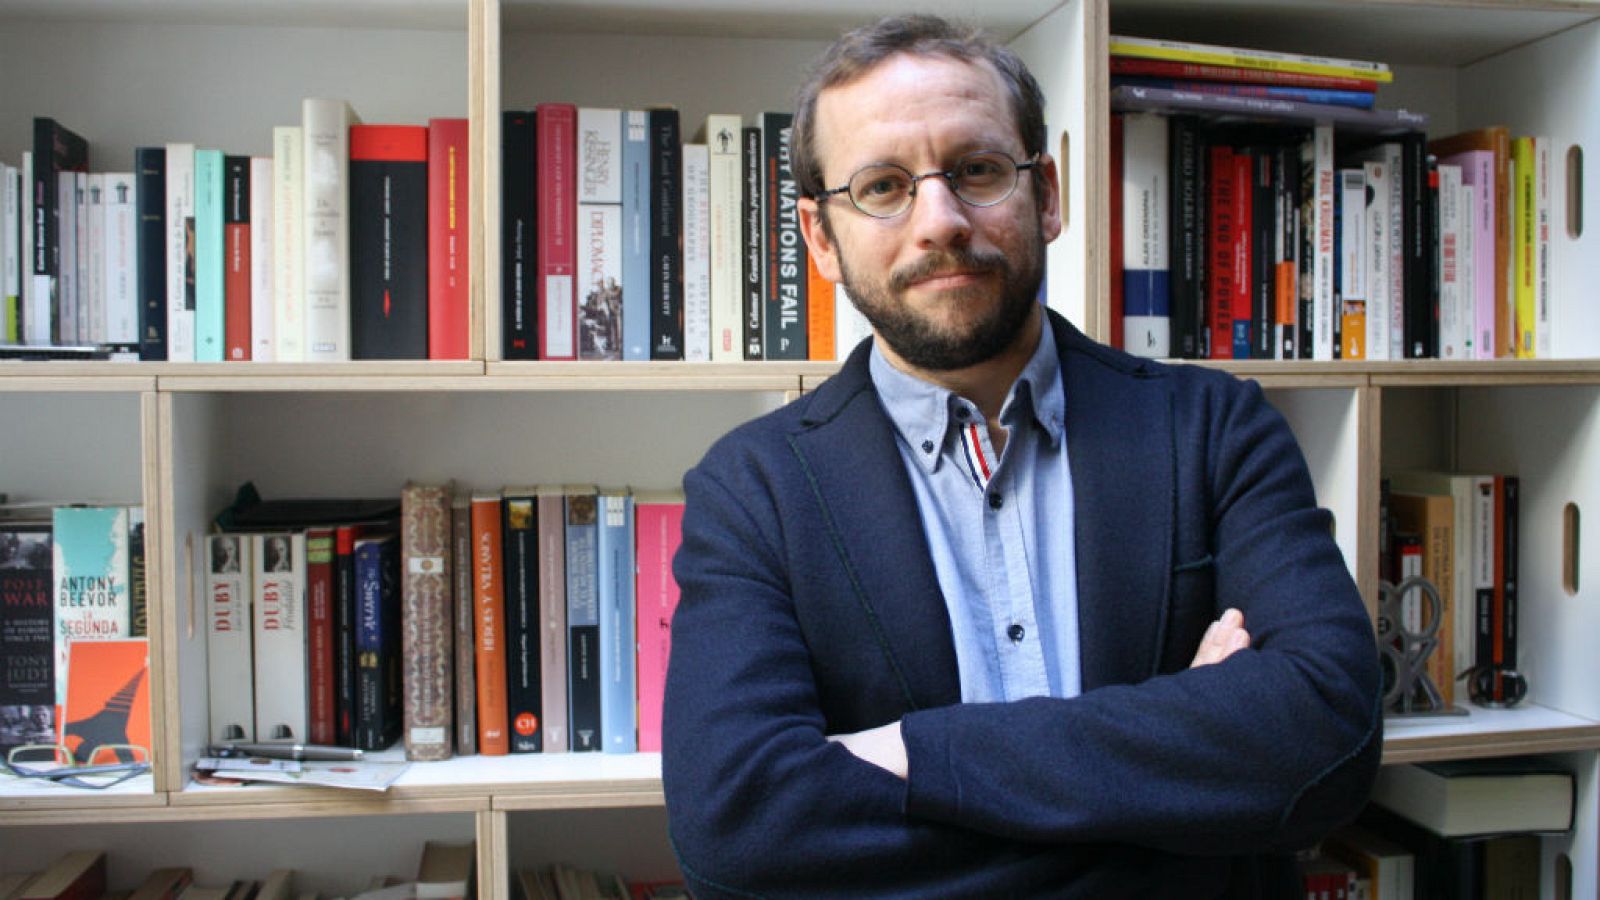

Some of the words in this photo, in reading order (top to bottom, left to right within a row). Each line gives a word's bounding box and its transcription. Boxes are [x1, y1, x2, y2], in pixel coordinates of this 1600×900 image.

[660, 125, 672, 147] The
[779, 127, 794, 179] WHY
[584, 129, 598, 197] KISSINGER
[598, 139, 612, 187] HENRY
[1392, 155, 1402, 209] MICHAEL
[1216, 178, 1231, 204] THE
[1319, 170, 1333, 197] PAUL
[660, 178, 672, 237] Continent
[1319, 200, 1333, 253] KRUGMAN
[779, 179, 798, 279] NATIONS
[1216, 213, 1231, 243] END
[590, 209, 605, 289] DIPLOMACY
[1216, 251, 1231, 269] OF
[779, 283, 798, 329] FAIL
[1216, 276, 1231, 331] POWER
[4, 593, 49, 606] WAR
[60, 576, 116, 591] ANTONY
[60, 592, 117, 607] BEEVOR
[362, 580, 379, 632] Swerve
[60, 620, 119, 635] SEGUNDA
[8, 655, 48, 667] TONY
[8, 667, 49, 681] JUDT
